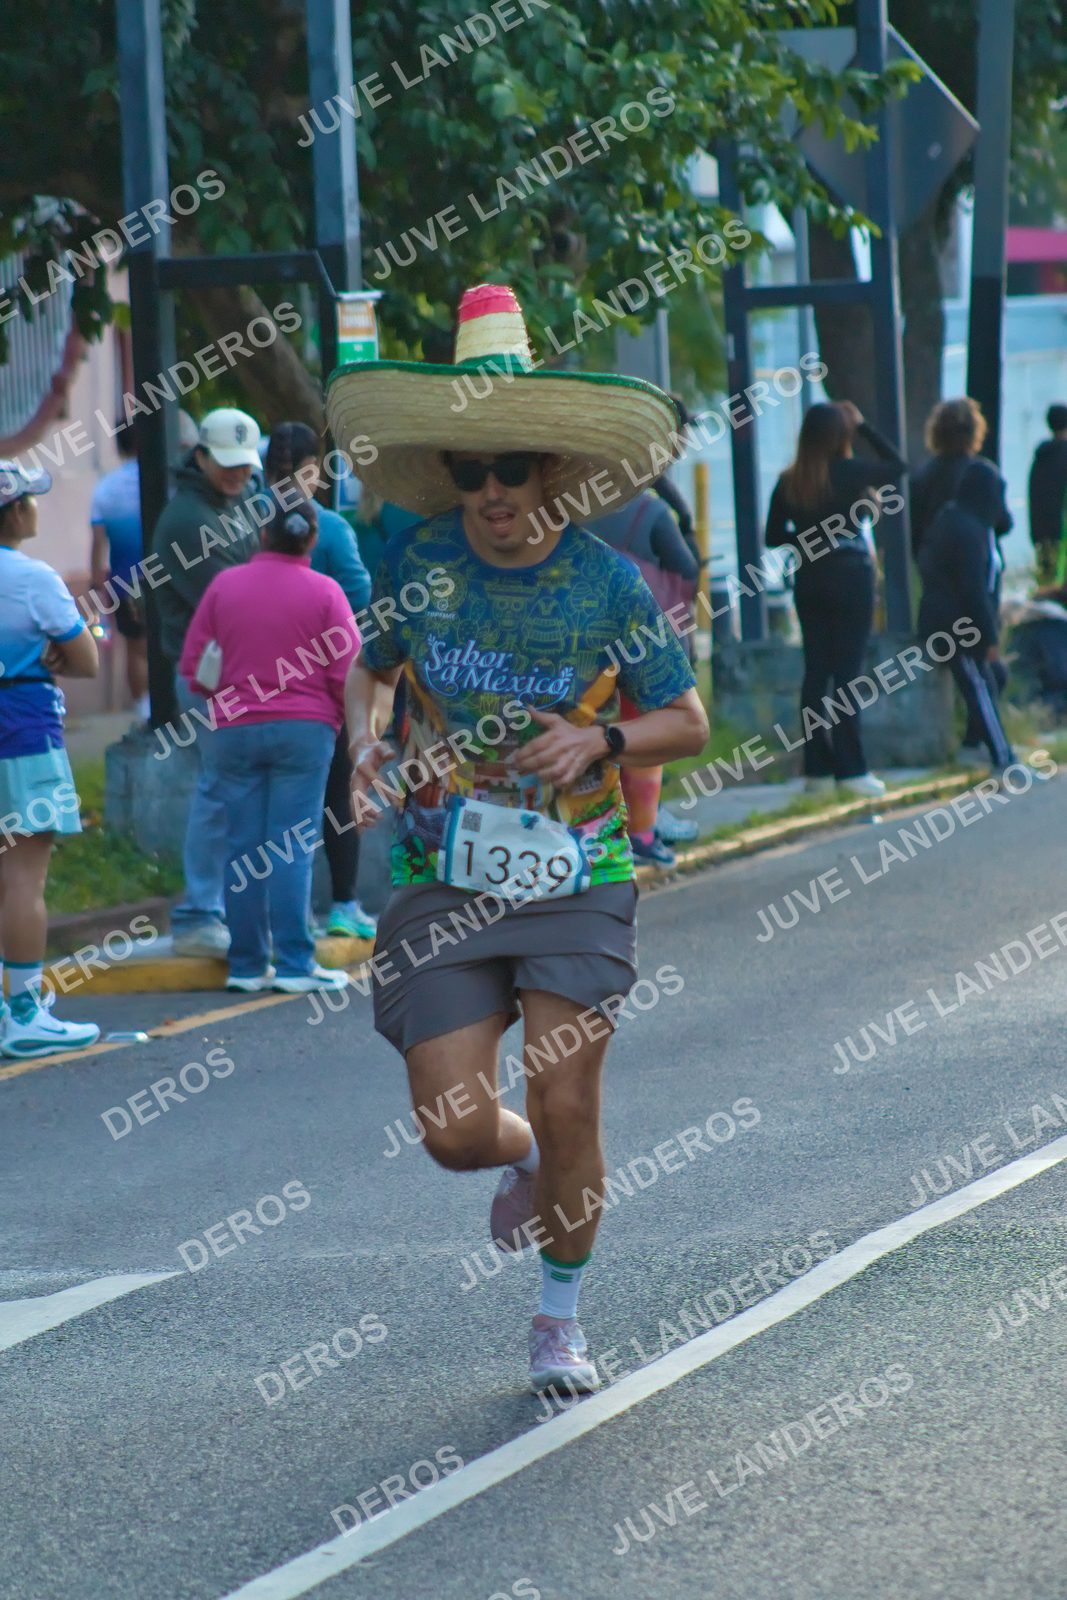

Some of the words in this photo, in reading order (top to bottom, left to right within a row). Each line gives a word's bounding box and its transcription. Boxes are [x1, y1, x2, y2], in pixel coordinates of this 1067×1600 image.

[425, 638, 513, 672] Sabor
[463, 667, 571, 695] México
[463, 840, 572, 893] 1339
